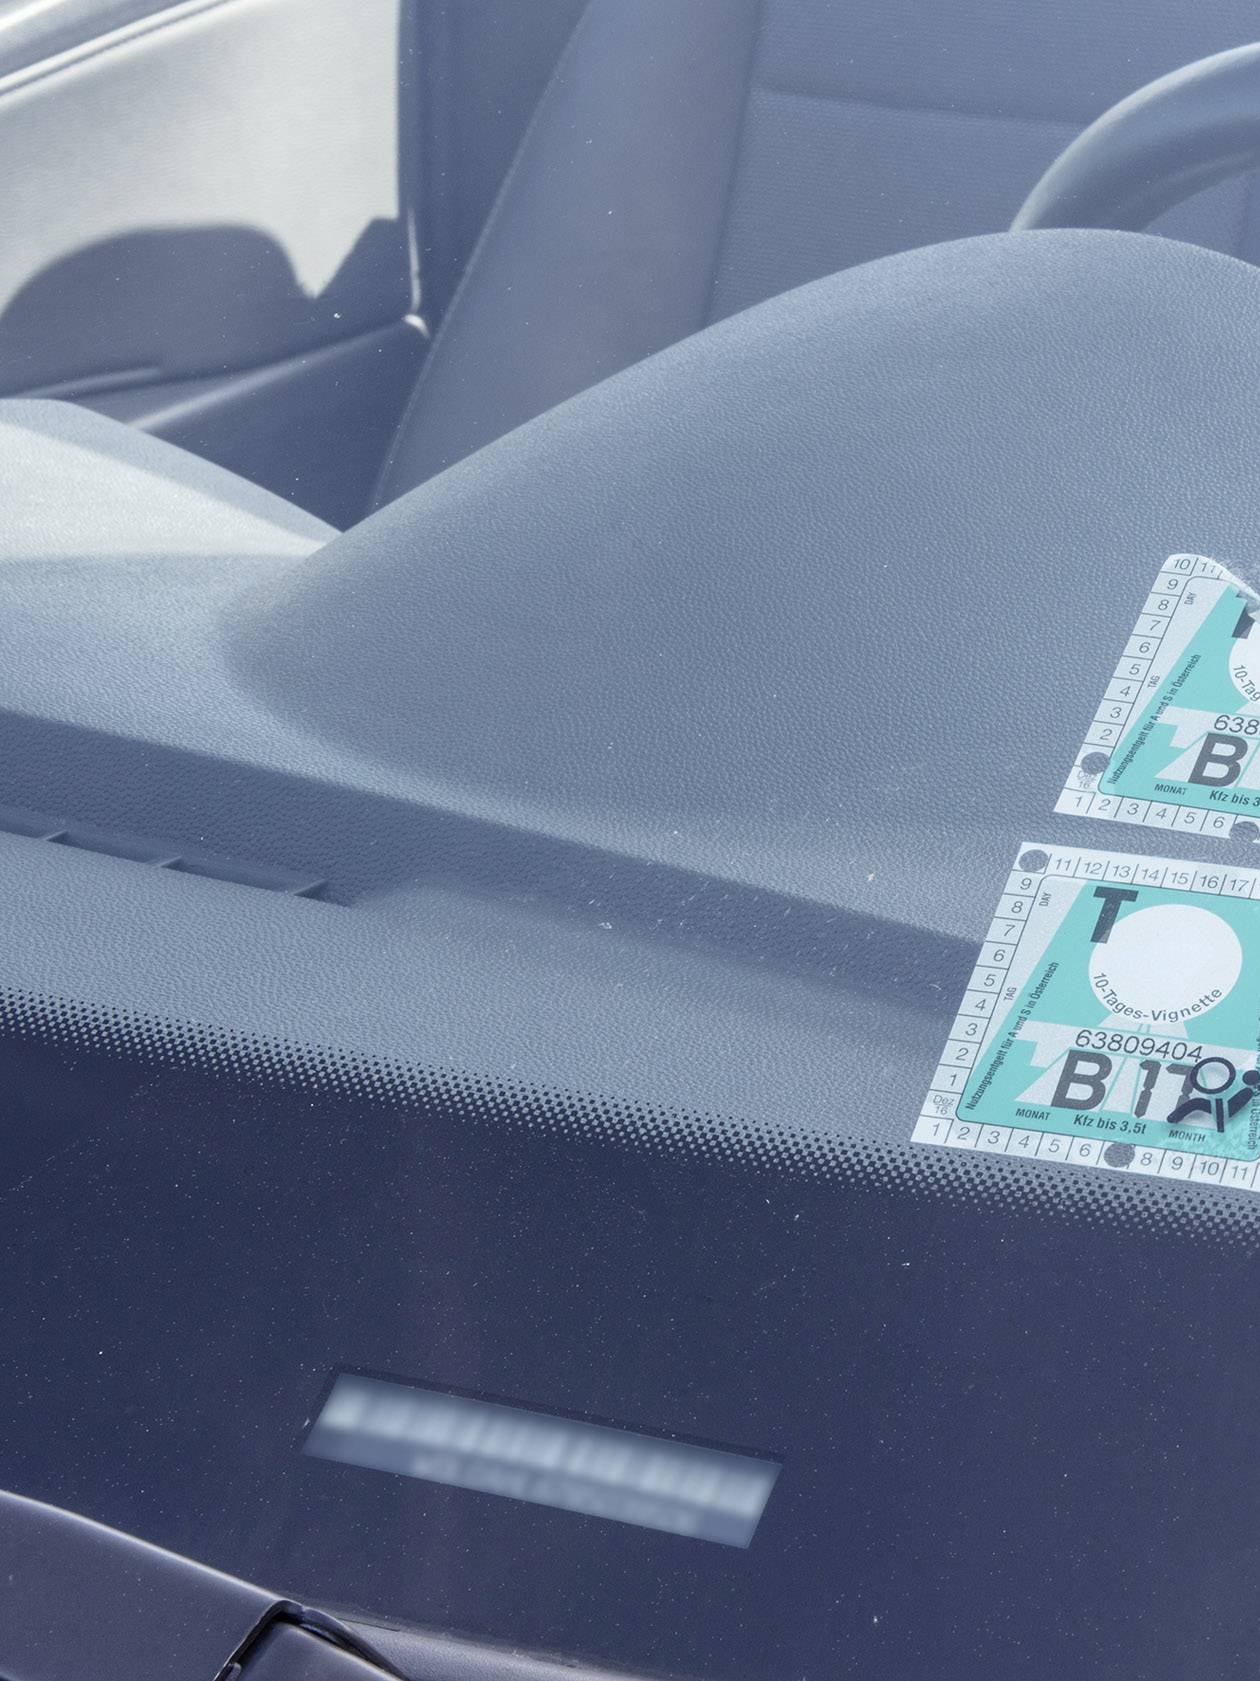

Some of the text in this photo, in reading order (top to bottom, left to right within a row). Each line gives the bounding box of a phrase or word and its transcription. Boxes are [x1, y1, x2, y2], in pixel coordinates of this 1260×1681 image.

[1174, 558, 1190, 570] 10
[1168, 578, 1179, 590] 9
[1158, 599, 1170, 610] 8
[1184, 592, 1196, 605] DAY
[1149, 620, 1161, 631] 7
[1139, 642, 1151, 654] 6
[1129, 664, 1142, 675] 5
[1147, 675, 1160, 688] TAG
[1120, 686, 1131, 696] 4
[1110, 706, 1122, 718] 3
[1100, 728, 1112, 741] 2
[1188, 733, 1248, 787] B
[1154, 784, 1188, 796] MONAT
[1210, 790, 1228, 802] Kfz
[1232, 794, 1250, 805] bis
[1076, 797, 1082, 808] 1
[1098, 800, 1111, 811] 2
[1127, 803, 1140, 815] 3
[1156, 808, 1168, 820] 4
[1184, 812, 1196, 824] 5
[1213, 816, 1226, 828] 6
[1056, 857, 1072, 872] 11
[1084, 862, 1102, 875] 12
[1112, 865, 1131, 878] 13
[1142, 868, 1160, 882] 14
[1171, 872, 1189, 885] 15
[1200, 875, 1220, 889] 16
[1230, 879, 1249, 892] 17
[1020, 878, 1032, 890] 9
[1039, 892, 1052, 907] DAY
[1011, 900, 1024, 914] 8
[1091, 886, 1139, 944] T
[1003, 924, 1016, 937] 7
[993, 948, 1006, 962] 6
[984, 974, 996, 986] 5
[1004, 986, 1017, 1001] TAG
[1094, 972, 1222, 1023] 10-Tages-Vignette
[975, 998, 986, 1012] 4
[965, 1022, 978, 1036] 3
[1075, 1029, 1202, 1062] 63809404
[956, 1047, 969, 1061] 2
[965, 1050, 1006, 1110] Nutzungsentgelt
[1014, 1016, 1028, 1032] und
[950, 1074, 957, 1086] 1
[1050, 1049, 1112, 1110] B
[936, 1105, 948, 1115] 16
[1016, 1108, 1051, 1120] MONAT
[1074, 1114, 1093, 1128] Kfz
[1099, 1118, 1117, 1132] bis
[1168, 1130, 1206, 1143] MONTH
[932, 1124, 1248, 1181] 1 2 3 4 5 6 8 9 10 11
